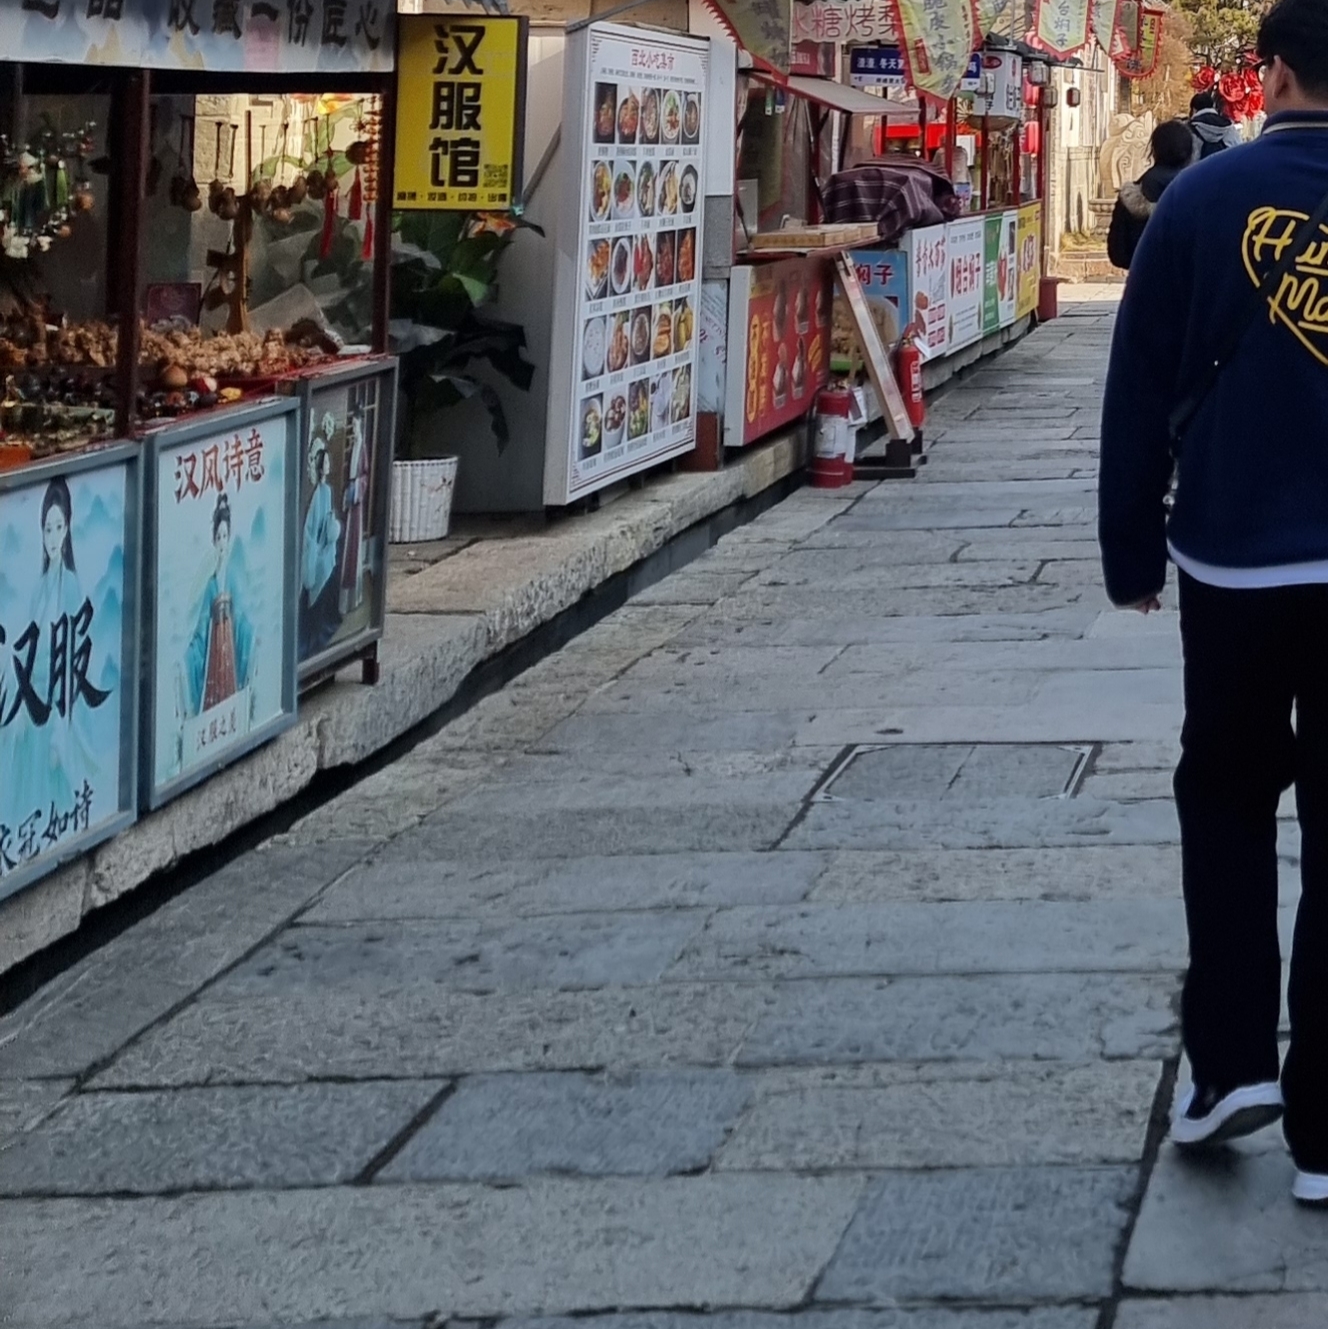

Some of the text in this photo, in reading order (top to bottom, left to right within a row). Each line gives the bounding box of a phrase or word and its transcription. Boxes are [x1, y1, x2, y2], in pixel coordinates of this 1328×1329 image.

[429, 24, 486, 188] 汉服馆
[174, 428, 265, 504] 汉风诗意
[0, 595, 114, 728] 汉服
